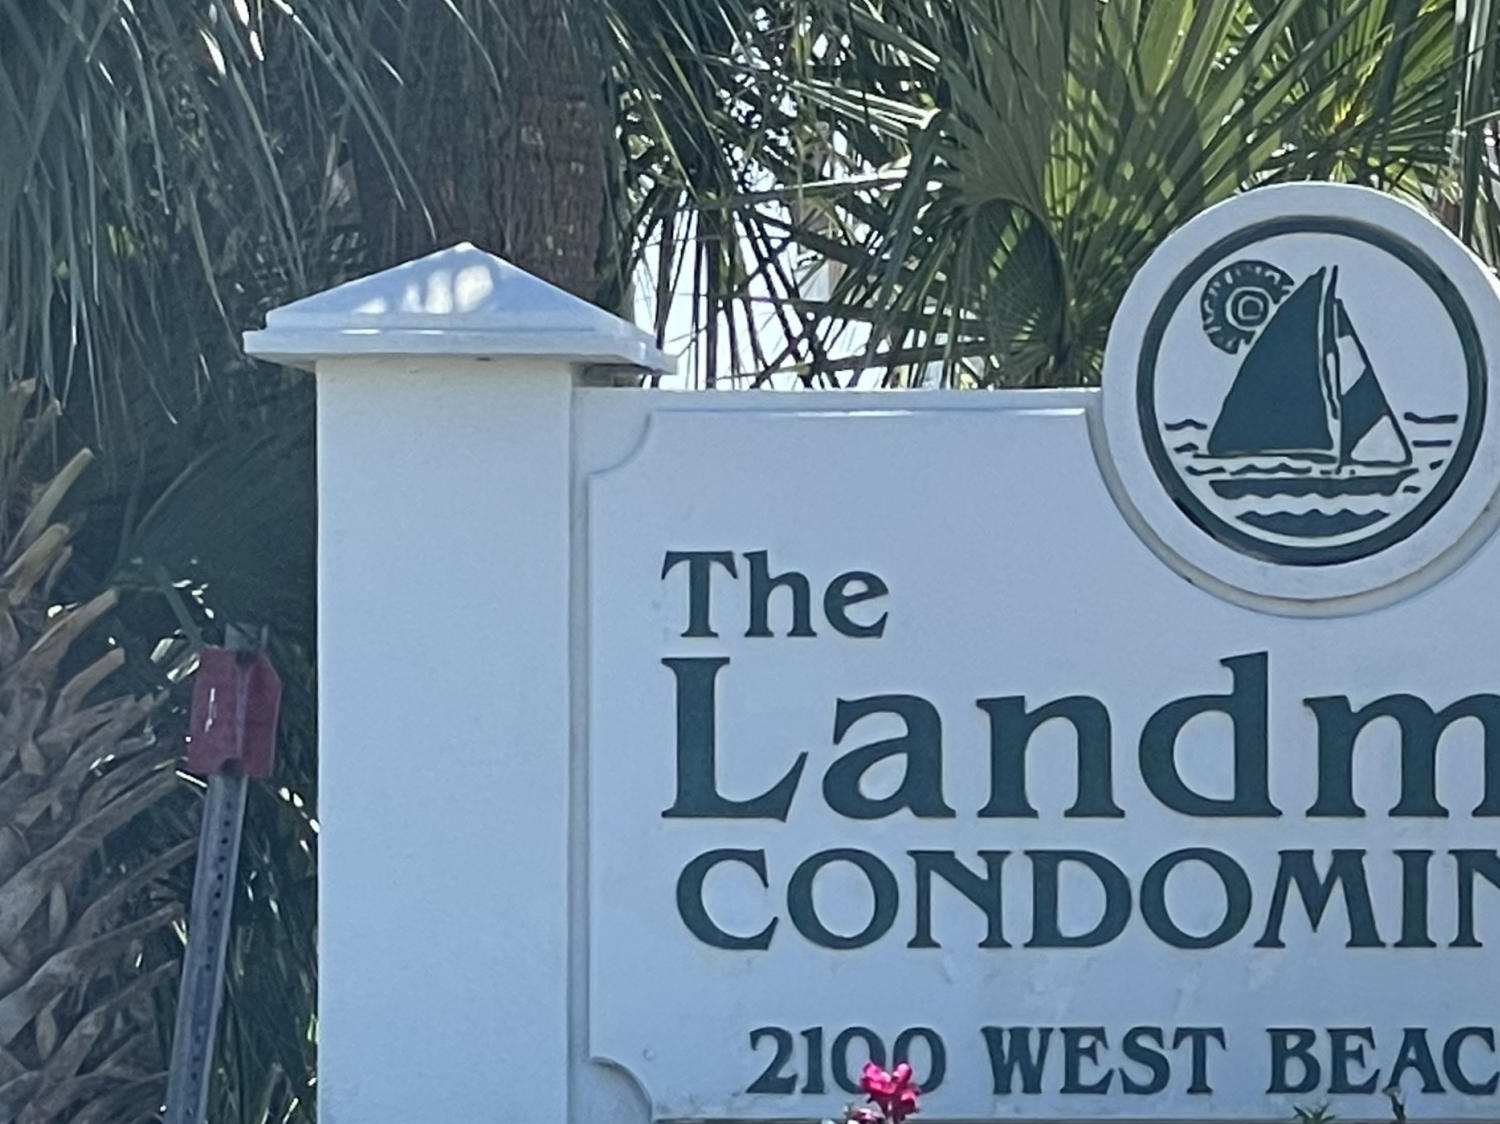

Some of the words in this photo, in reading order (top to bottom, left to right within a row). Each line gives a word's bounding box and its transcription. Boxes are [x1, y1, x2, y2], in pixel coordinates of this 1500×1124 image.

[661, 550, 889, 639] The
[748, 1026, 947, 1094] 2100
[982, 1026, 1226, 1094] WEST
